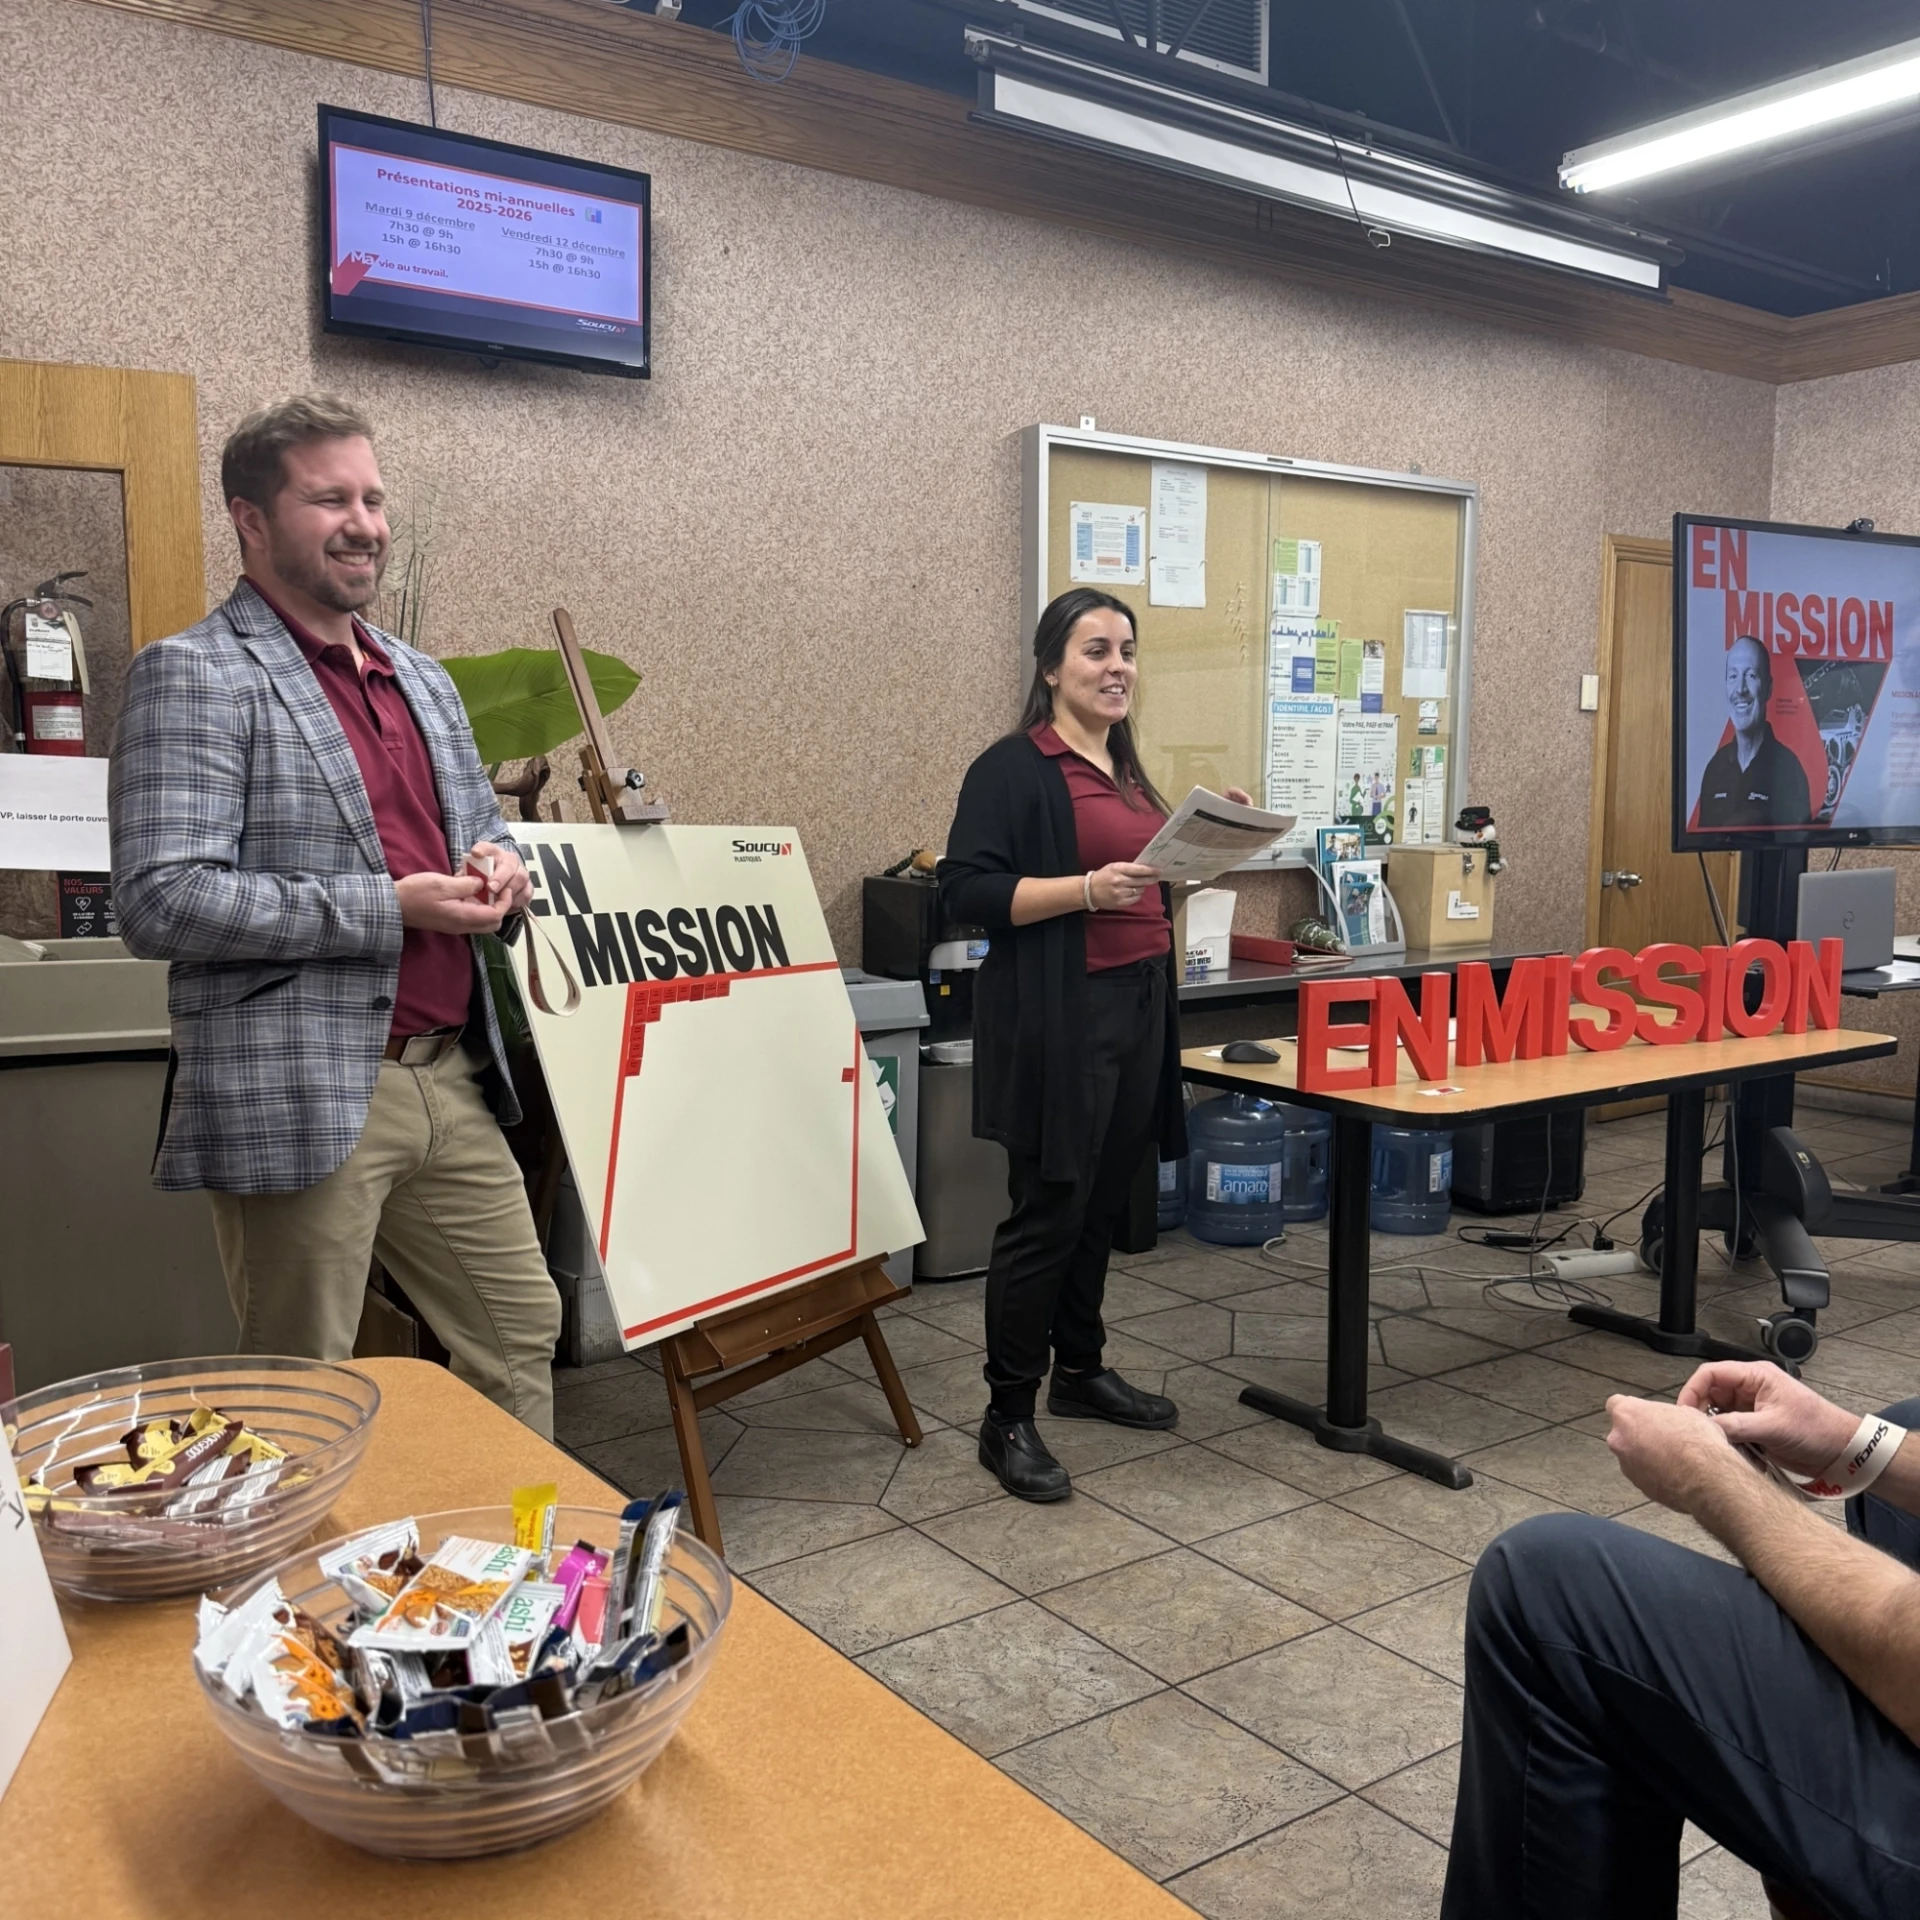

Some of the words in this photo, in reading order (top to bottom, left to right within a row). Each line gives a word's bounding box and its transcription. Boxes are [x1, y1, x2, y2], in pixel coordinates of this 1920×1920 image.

[377, 168, 480, 198] Présentations
[484, 191, 575, 217] mi-annuelles
[365, 201, 402, 217] Mardi
[405, 209, 413, 218] 9
[416, 211, 476, 231] décembre
[457, 198, 532, 222] 2025-2026
[382, 233, 404, 245] 15h
[408, 238, 421, 248] @
[425, 240, 461, 255] 16h30
[389, 220, 419, 234] 7h30
[422, 226, 435, 237] @
[438, 228, 454, 240] 9h
[501, 226, 552, 244] Vendredi
[555, 237, 569, 248] 12
[571, 240, 626, 258] décembre
[351, 252, 375, 265] Ma
[378, 259, 395, 269] vie
[397, 264, 411, 272] au
[413, 264, 449, 278] travail.
[529, 259, 549, 271] 15h
[552, 263, 564, 273] @
[567, 265, 601, 279] 16h30
[535, 247, 562, 260] 7h30
[565, 252, 577, 262] @
[580, 255, 594, 265] 9h
[575, 319, 616, 332] Soucy
[1692, 526, 1747, 591] EN
[1725, 590, 1894, 660] MISSION
[16, 812, 47, 821] laisser
[49, 813, 58, 821] la
[60, 814, 84, 822] porte
[732, 840, 781, 856] Soucy
[64, 886, 104, 894] VALEURS
[564, 904, 791, 987] MISSION
[1297, 971, 1451, 1092] EN
[1455, 937, 1844, 1067] MISSION
[1854, 1422, 1889, 1468] Soucy
[482, 1545, 520, 1576] ashi
[504, 1597, 535, 1633] ashi
